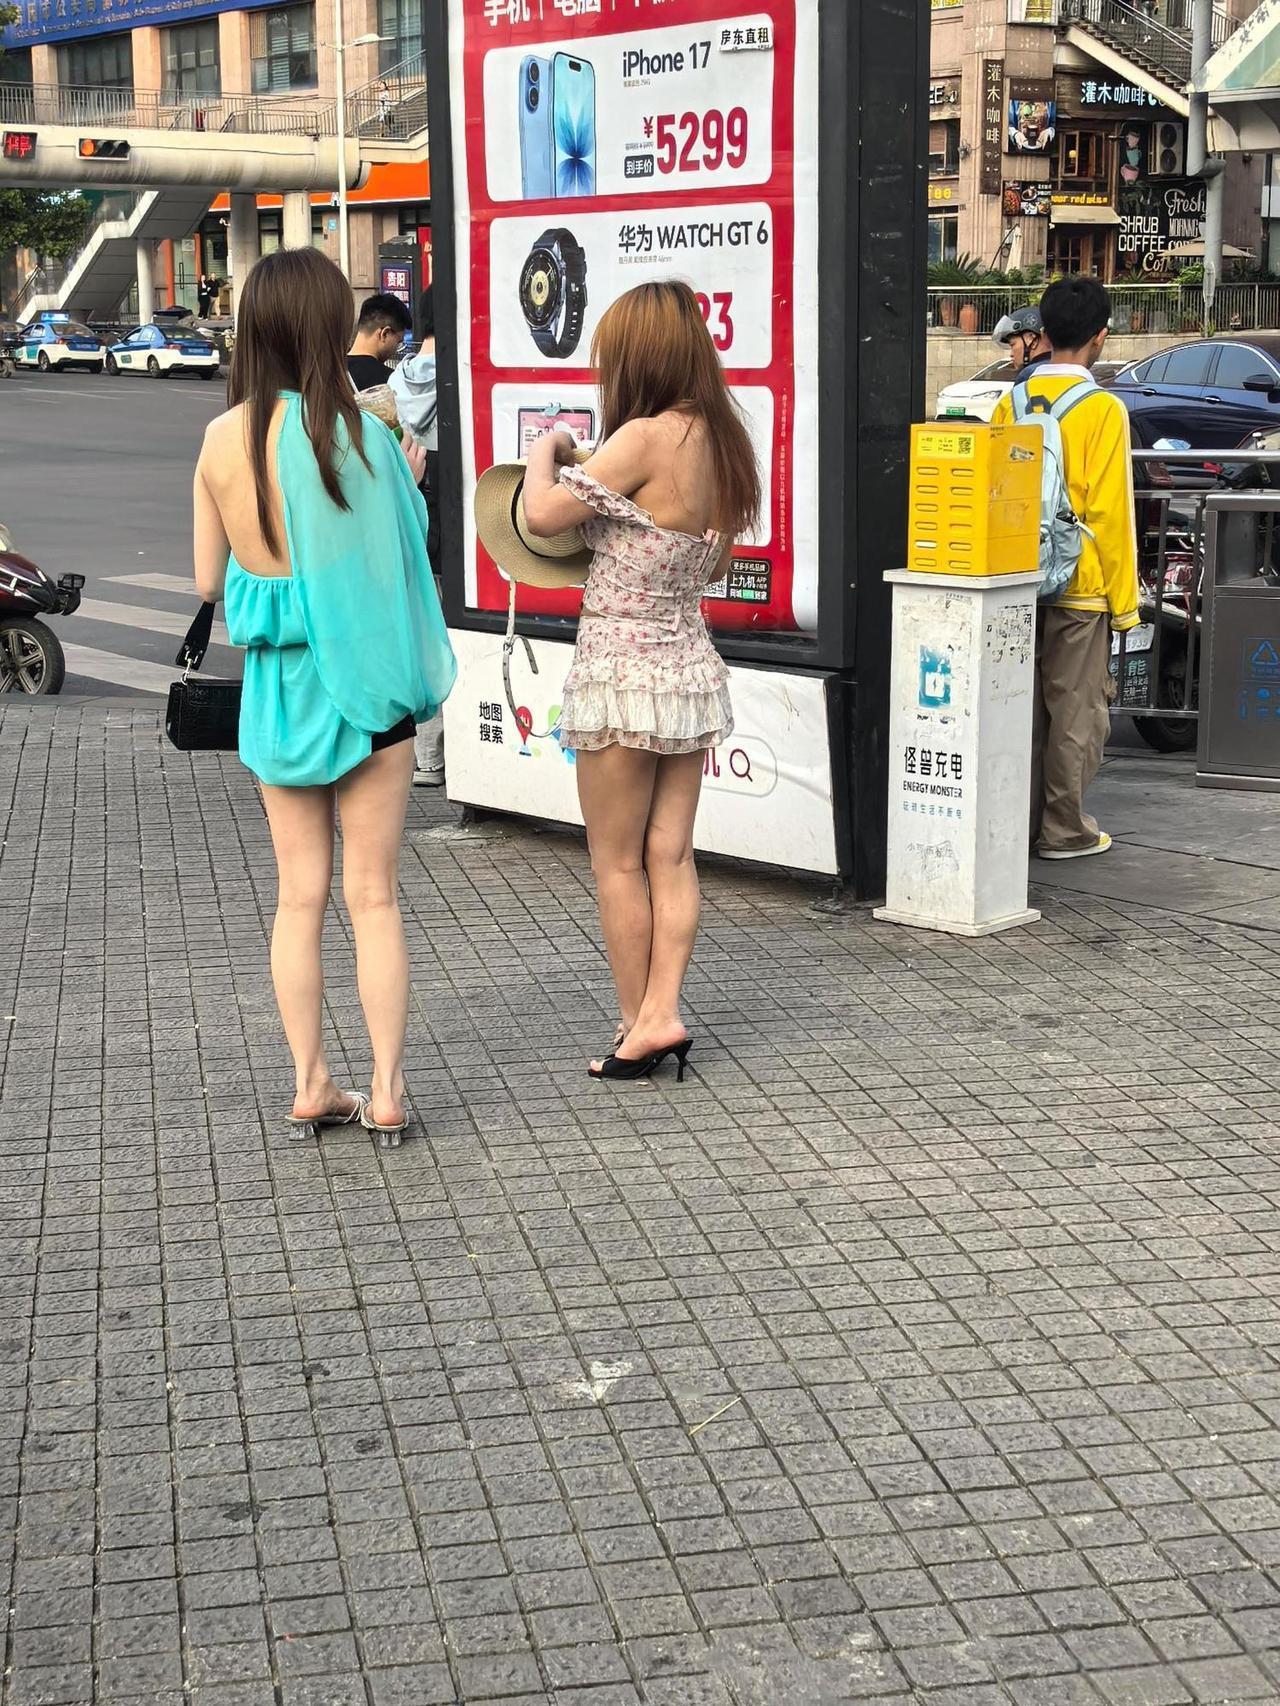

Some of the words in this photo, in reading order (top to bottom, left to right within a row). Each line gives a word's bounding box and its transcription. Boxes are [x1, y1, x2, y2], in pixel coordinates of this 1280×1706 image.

[484, 0, 530, 26] 手机
[721, 27, 769, 45] 房东直租
[623, 49, 684, 77] iPhone
[689, 41, 711, 69] 17
[986, 64, 1001, 143] 灌木咖啡
[1080, 81, 1146, 106] 灌木咖啡
[626, 159, 652, 175] 到手价
[1164, 188, 1206, 216] Fresh
[1120, 215, 1159, 234] SHRUB
[618, 223, 652, 252] 华为
[657, 222, 723, 250] WATCH
[728, 221, 753, 247] GT
[757, 220, 769, 245] 6
[1118, 234, 1166, 252] COFFEE
[730, 574, 755, 588] 上九机
[479, 701, 502, 722] 地图
[480, 723, 503, 744] 搜索
[904, 746, 962, 780] 怪兽充电
[903, 780, 928, 794] ENERGY
[930, 784, 962, 798] MONSTER
